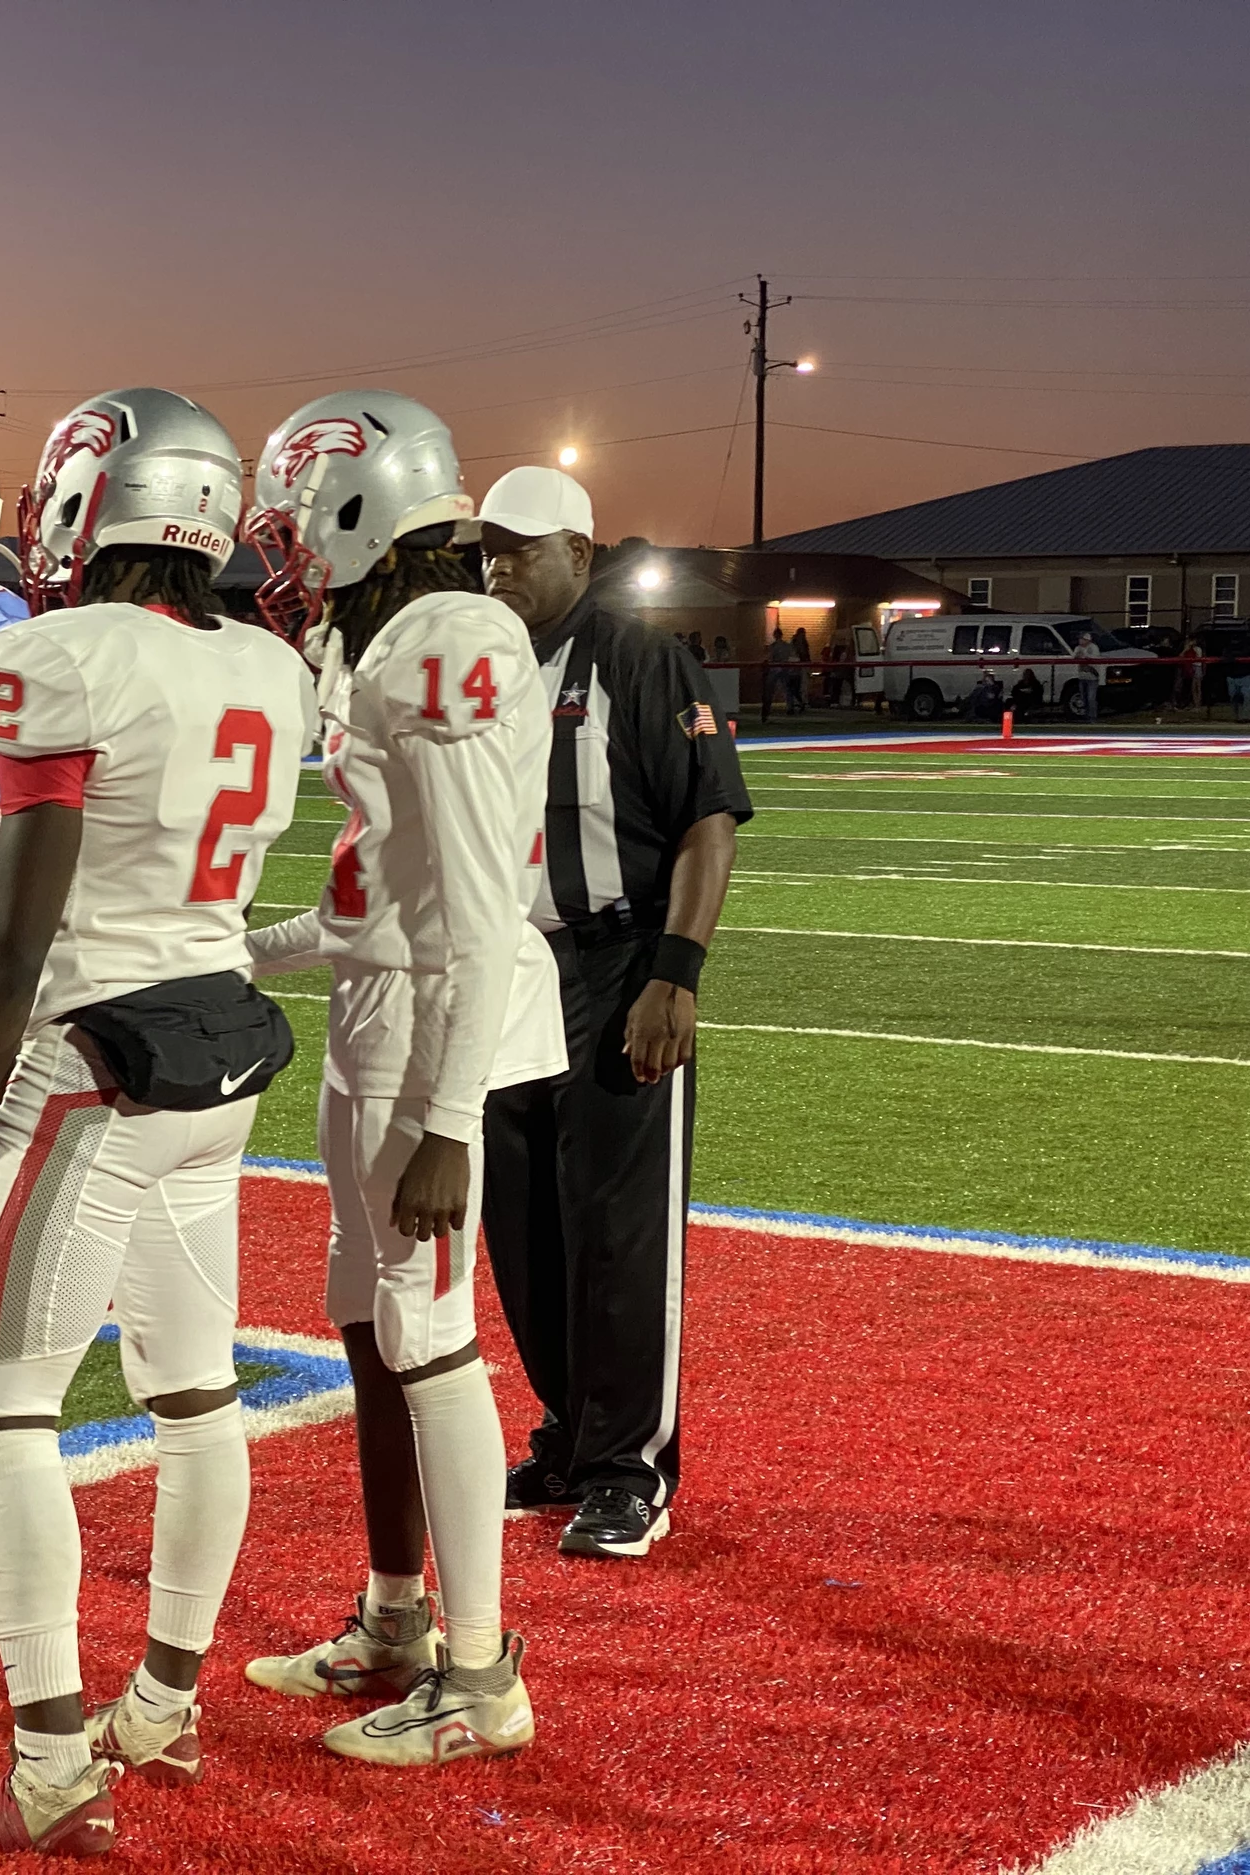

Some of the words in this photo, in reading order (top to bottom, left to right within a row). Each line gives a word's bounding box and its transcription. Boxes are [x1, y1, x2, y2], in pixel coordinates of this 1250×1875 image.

[161, 523, 231, 558] Riddell
[417, 654, 501, 722] 14
[182, 704, 275, 906] 2
